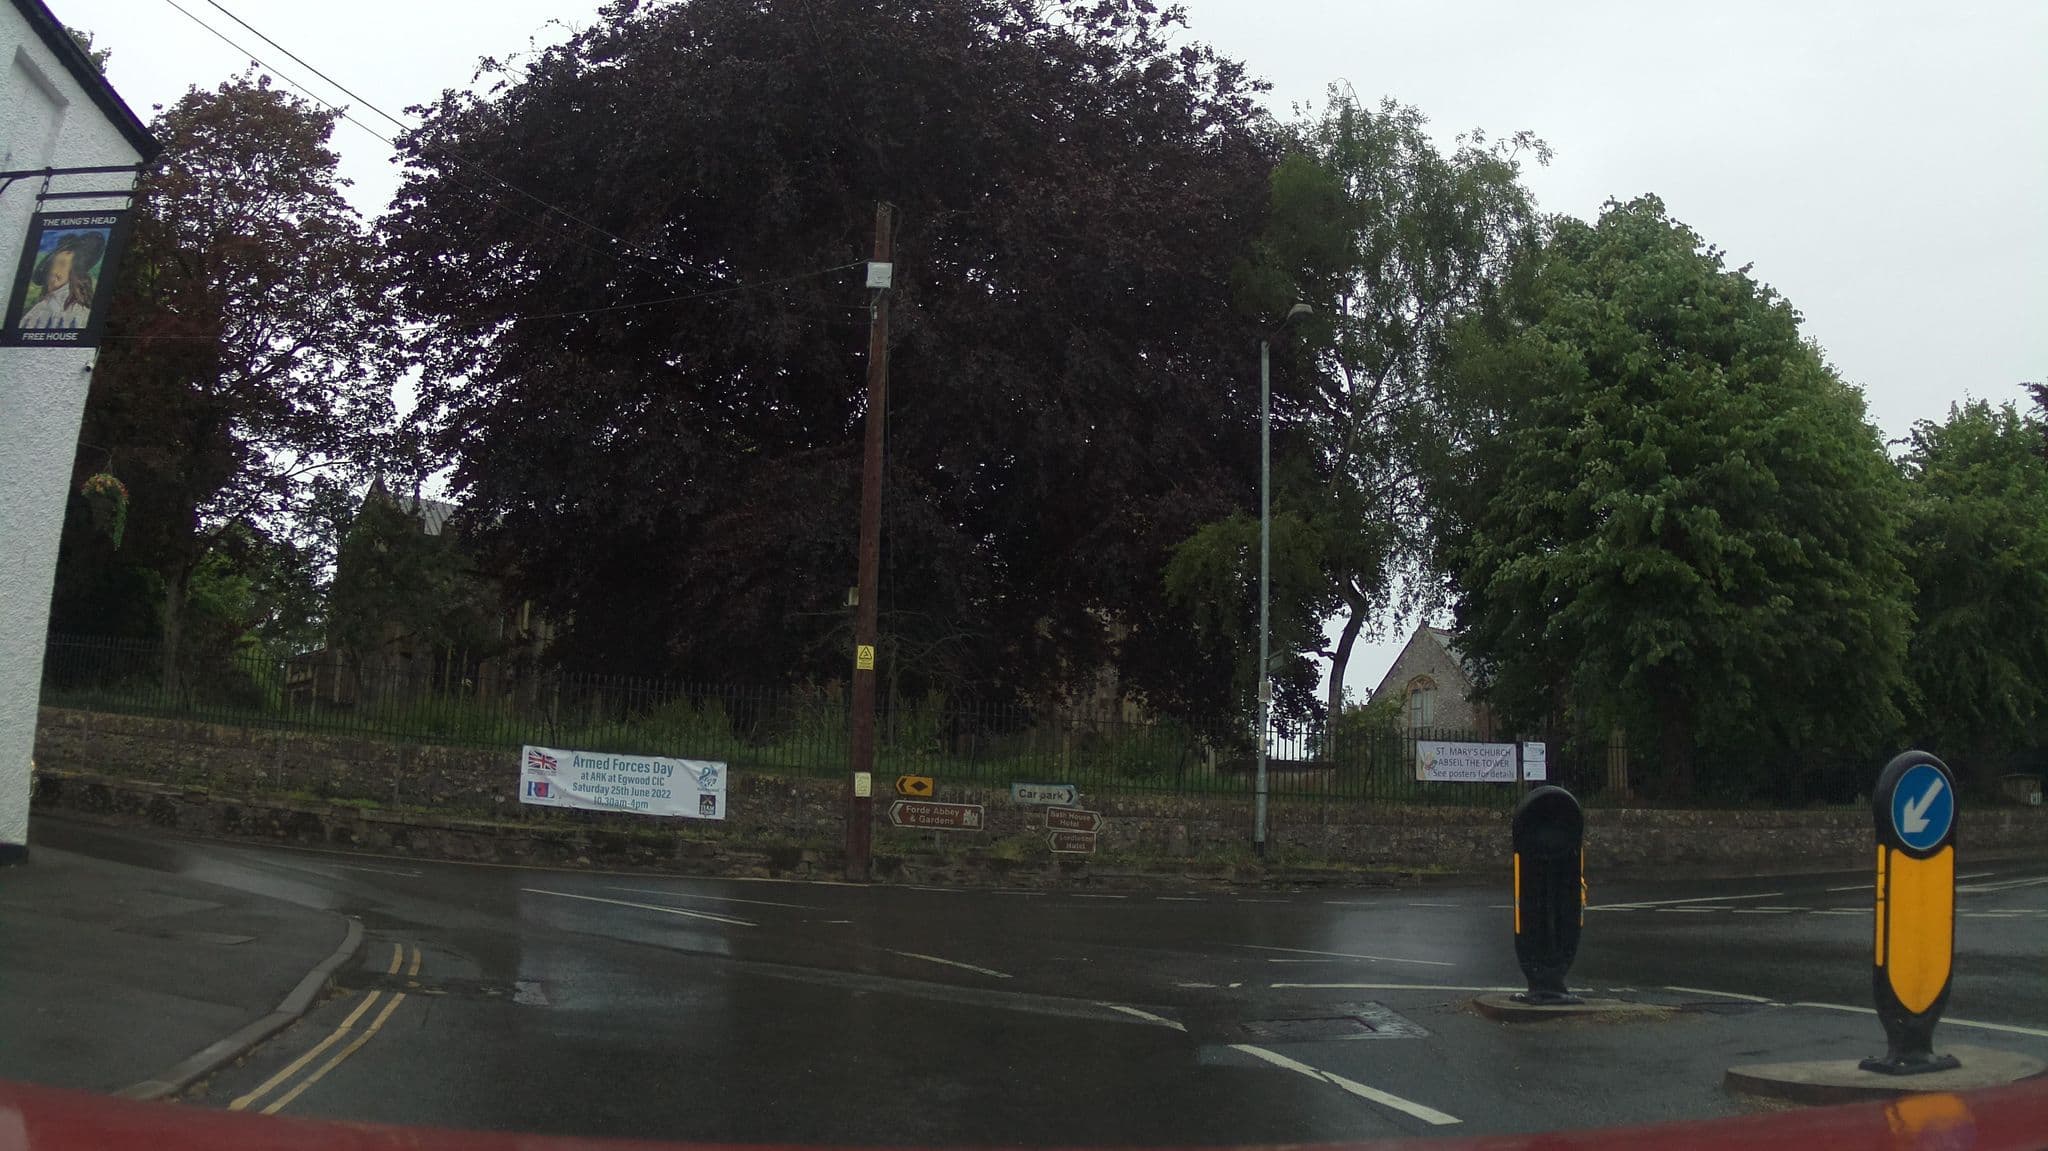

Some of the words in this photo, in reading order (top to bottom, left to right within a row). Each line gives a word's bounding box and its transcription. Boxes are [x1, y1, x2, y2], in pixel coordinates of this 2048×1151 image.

[43, 218, 60, 226] THE
[60, 218, 90, 226] KING'S
[91, 216, 117, 224] HEAD
[22, 332, 46, 340] FREE
[46, 332, 78, 340] HOUSE
[1450, 748, 1478, 756] MARY'S
[1480, 749, 1510, 757] CHURCH
[573, 755, 610, 770] Armed
[613, 758, 650, 772] Forces
[653, 762, 674, 777] Day
[1438, 759, 1464, 767] ABSEIL
[1466, 759, 1480, 767] THE
[1482, 760, 1509, 768] TOWER
[1449, 770, 1476, 778] posters
[580, 772, 589, 780] at
[590, 772, 607, 781] ARK
[608, 774, 616, 782] at
[618, 775, 650, 787] Egwood
[652, 777, 665, 786] CIC
[573, 783, 609, 796] Saturday
[611, 785, 629, 796] 25th
[630, 787, 650, 797] June
[651, 789, 671, 799] 2022
[1019, 789, 1036, 798] Car
[1040, 792, 1064, 800] park
[906, 805, 930, 814] Forde
[933, 807, 960, 817] Abbey
[920, 816, 954, 825] Gardens
